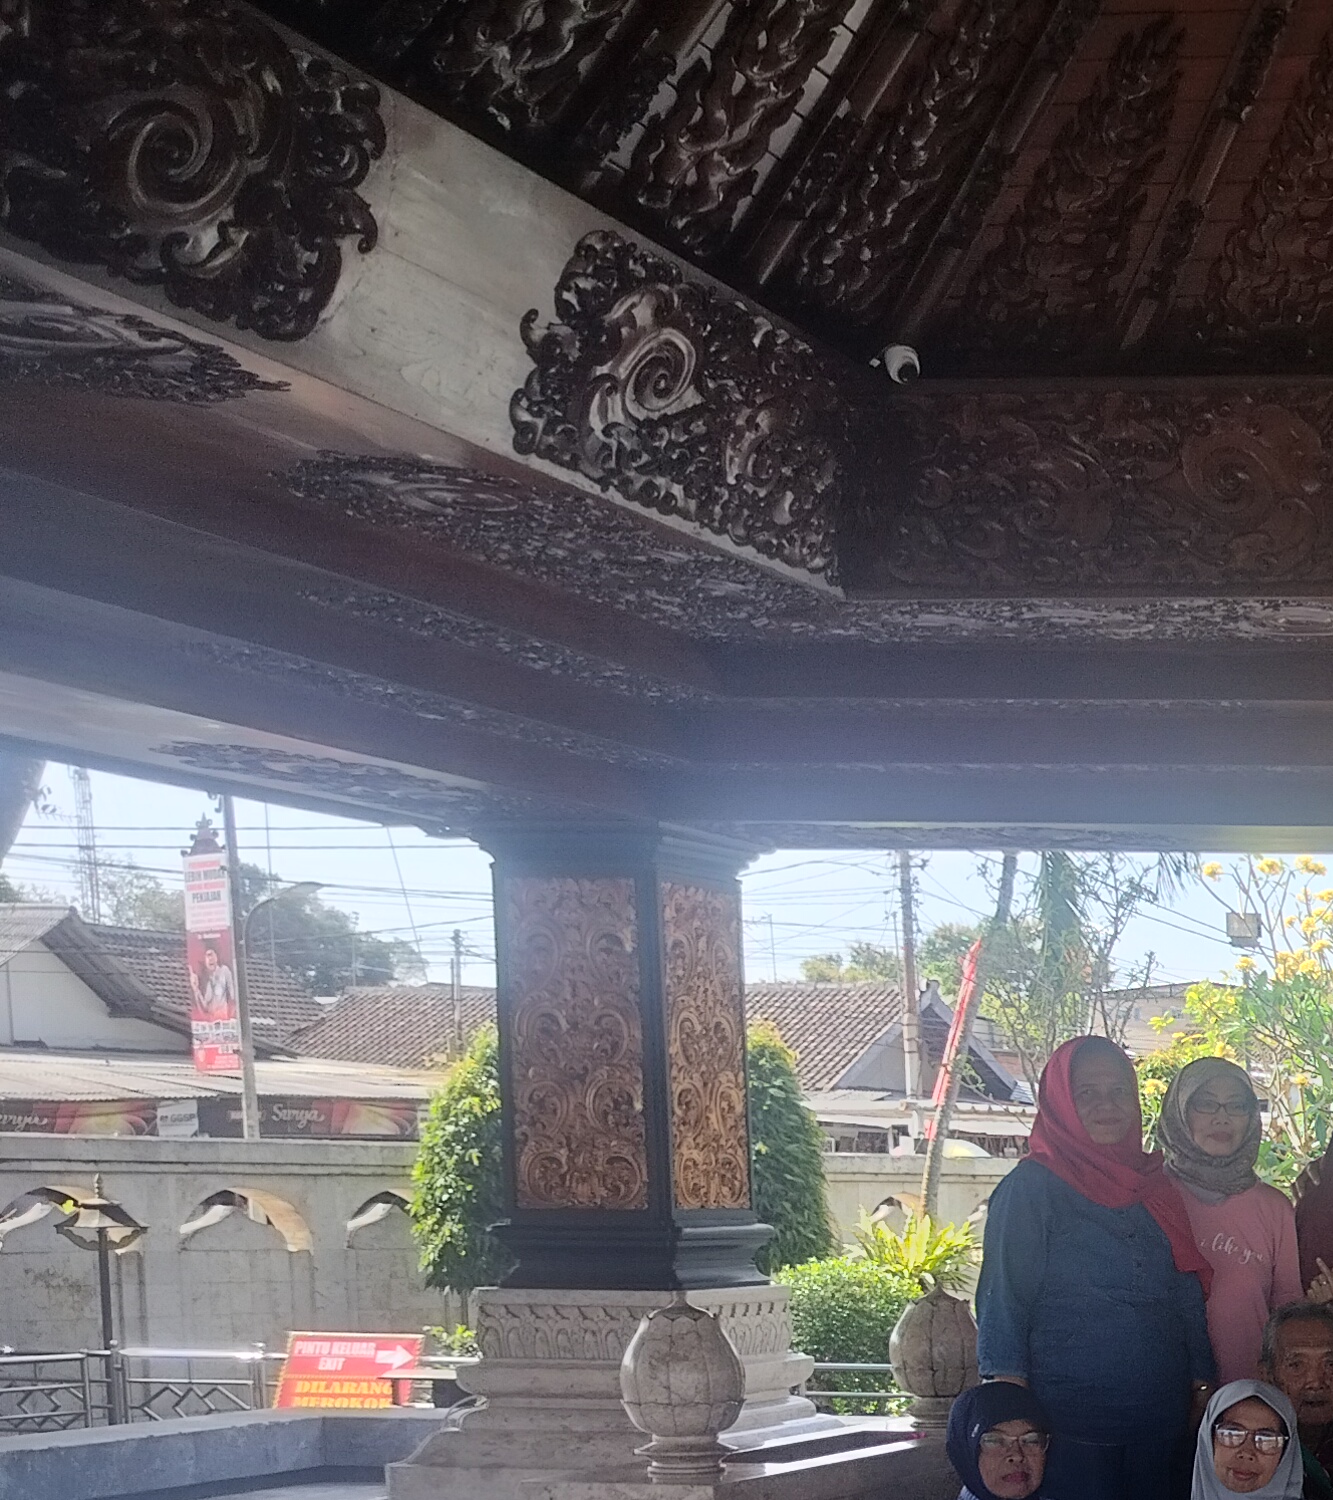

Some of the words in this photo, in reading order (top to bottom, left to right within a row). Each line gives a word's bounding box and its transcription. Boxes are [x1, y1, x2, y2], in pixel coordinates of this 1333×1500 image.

[170, 1113, 196, 1122] GGSP
[271, 1104, 325, 1128] Surya
[295, 1341, 331, 1354] PINTU
[331, 1342, 377, 1355] KELUAR
[318, 1358, 345, 1371] EXIT
